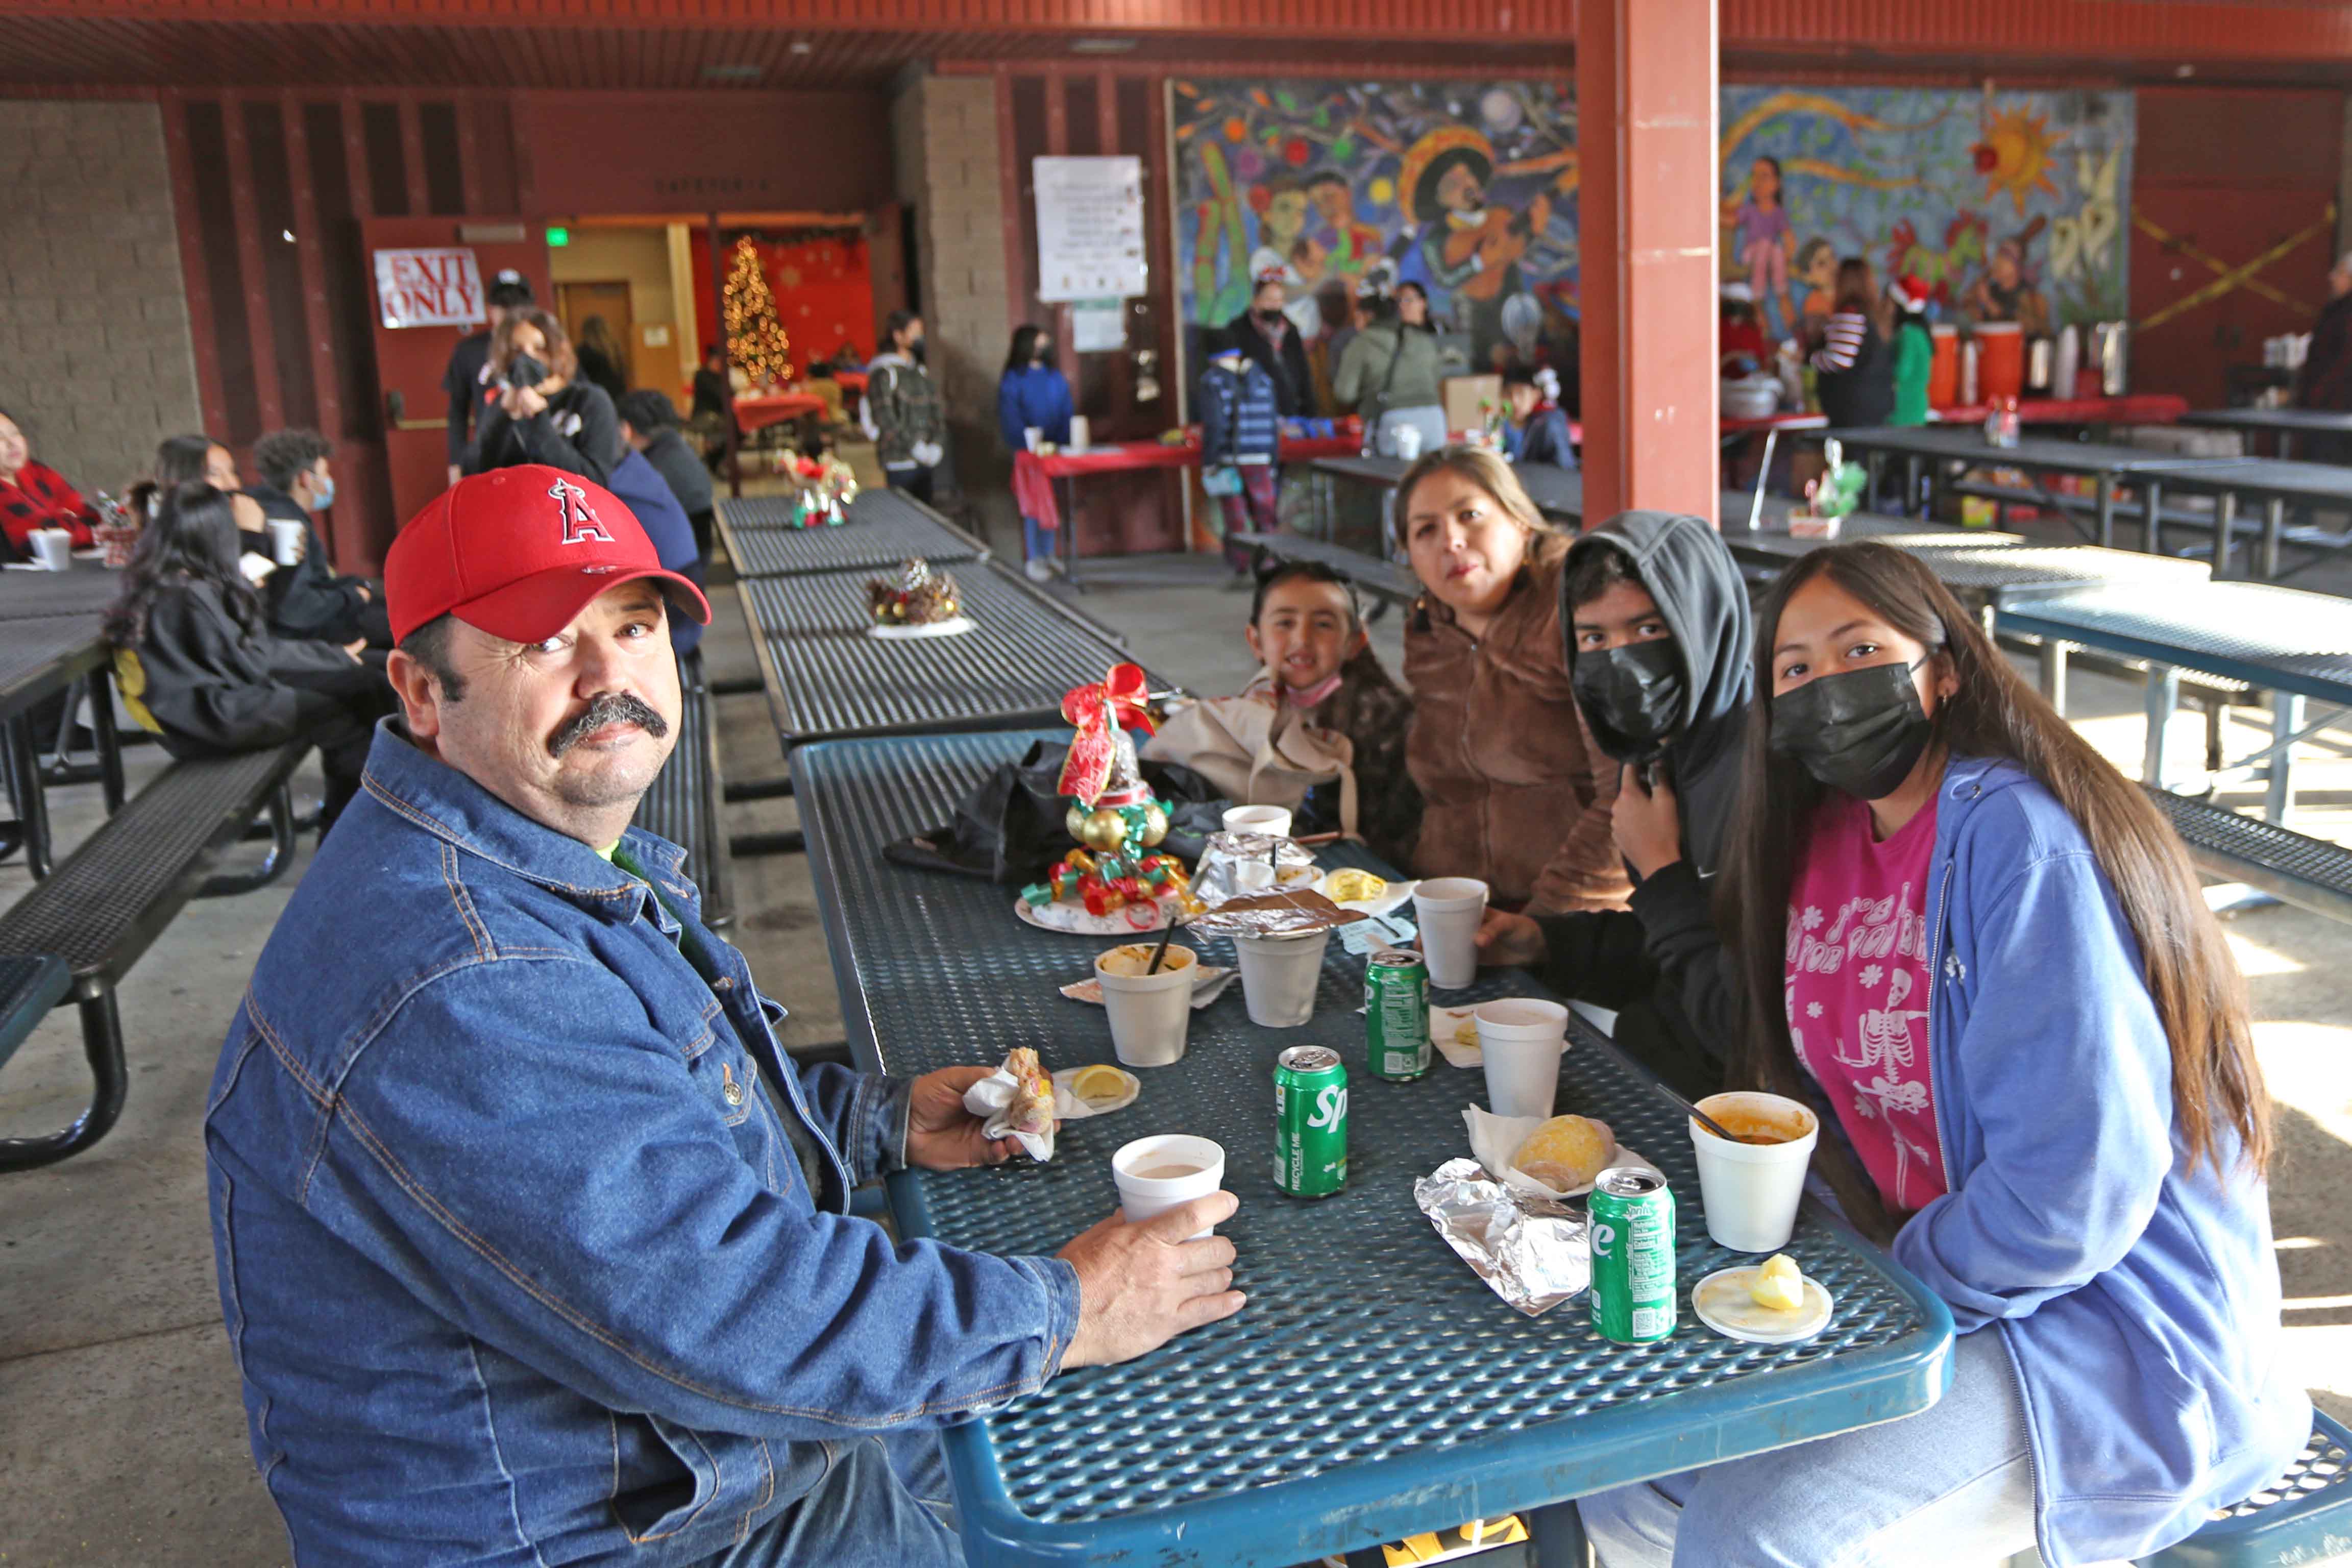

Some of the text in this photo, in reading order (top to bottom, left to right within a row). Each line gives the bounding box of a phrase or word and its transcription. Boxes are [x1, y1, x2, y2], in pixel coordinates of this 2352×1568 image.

[391, 255, 471, 287] EXIT
[385, 286, 476, 321] ONLY
[548, 478, 616, 545] A
[1291, 1132, 1301, 1191] RECYCLE ME
